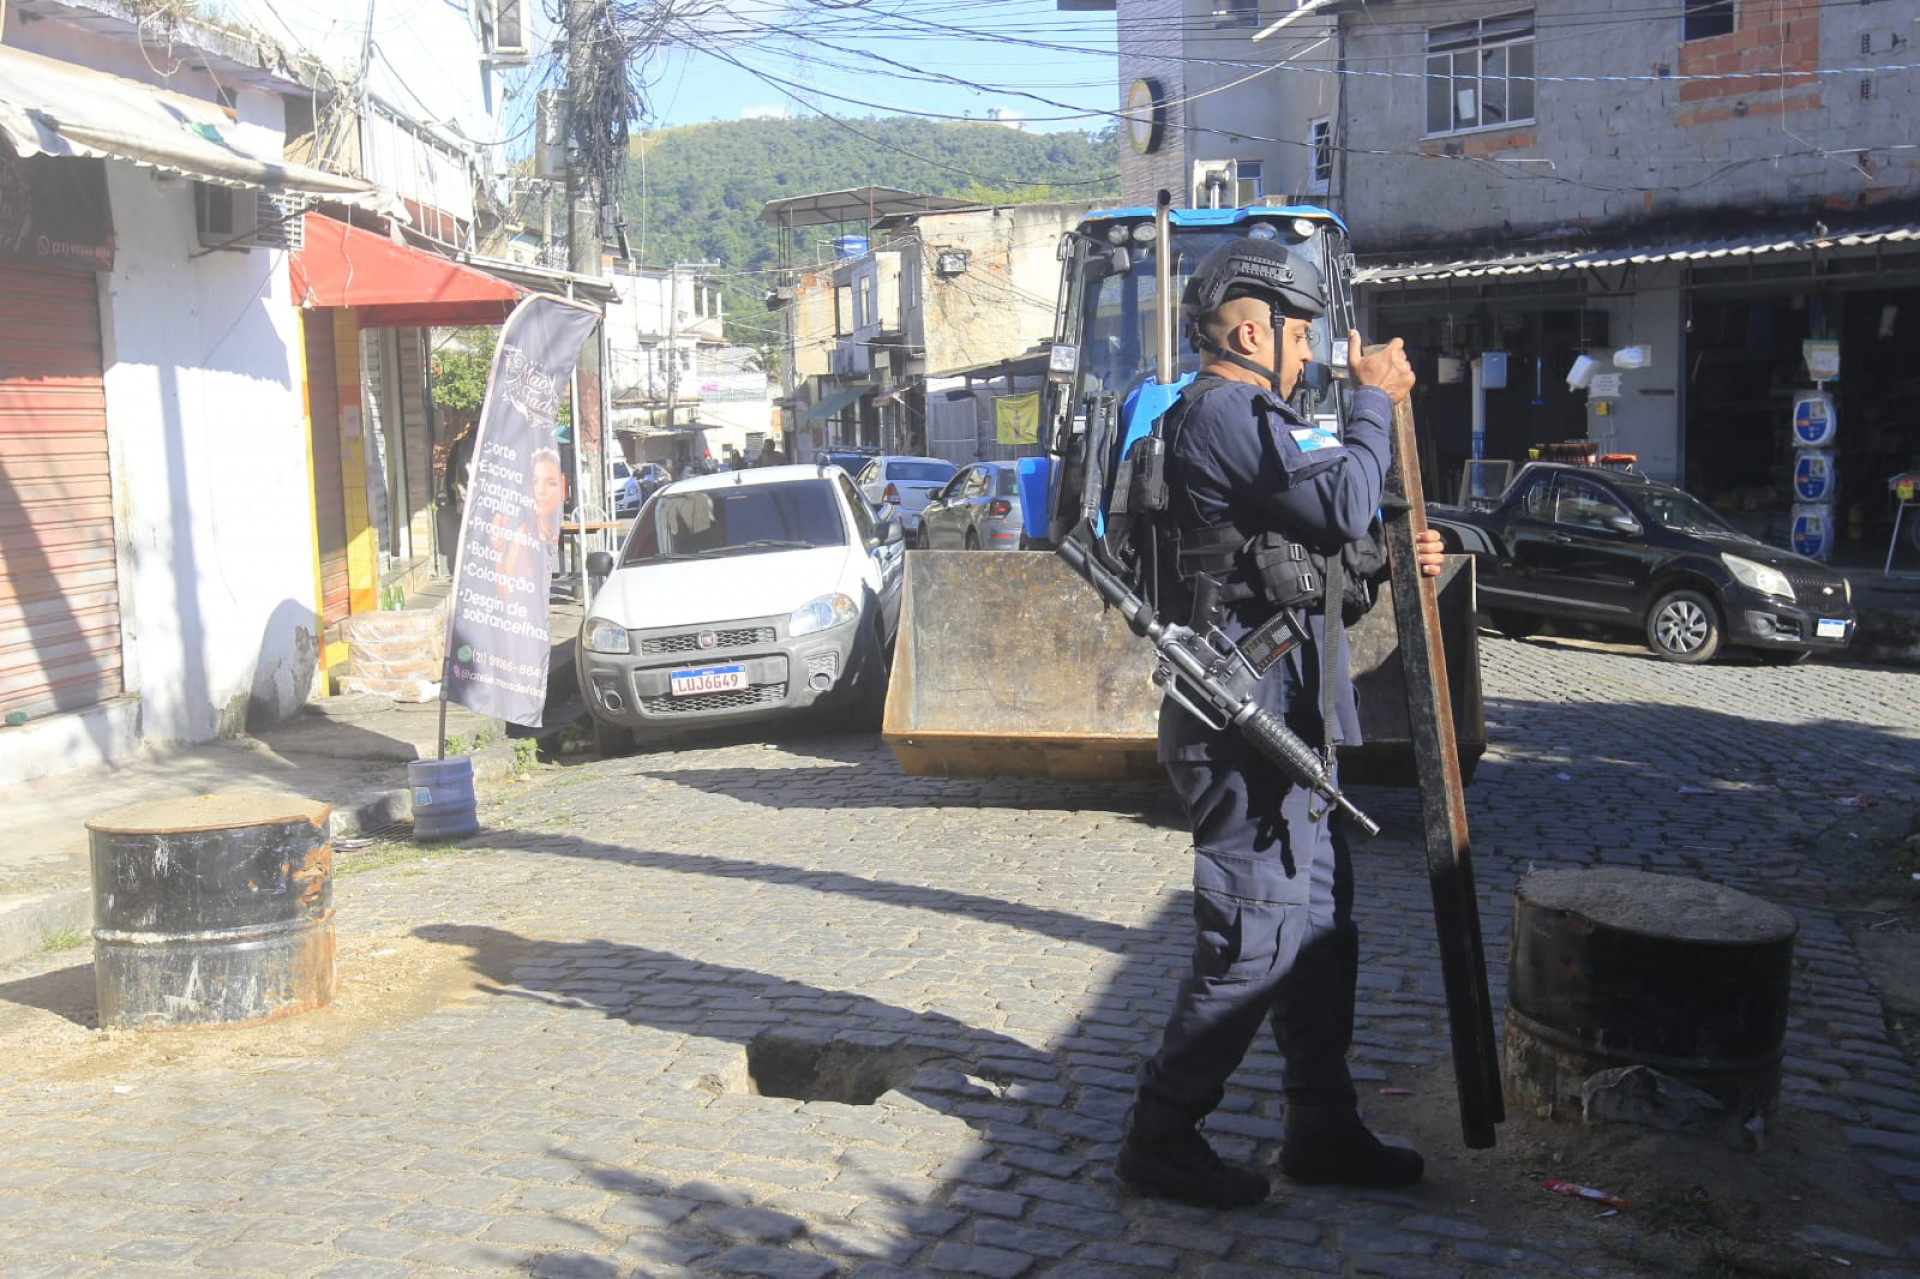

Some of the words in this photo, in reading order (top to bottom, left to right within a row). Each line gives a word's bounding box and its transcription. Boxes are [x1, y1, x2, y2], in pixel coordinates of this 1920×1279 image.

[484, 441, 517, 460] Corte
[479, 460, 523, 484] Escova
[478, 496, 520, 517] capilar
[467, 562, 535, 593] Coloração
[463, 588, 504, 613] Desgin
[507, 602, 527, 617] de
[463, 608, 549, 641] sobrancelhas
[678, 674, 738, 692] LUJ6G49
